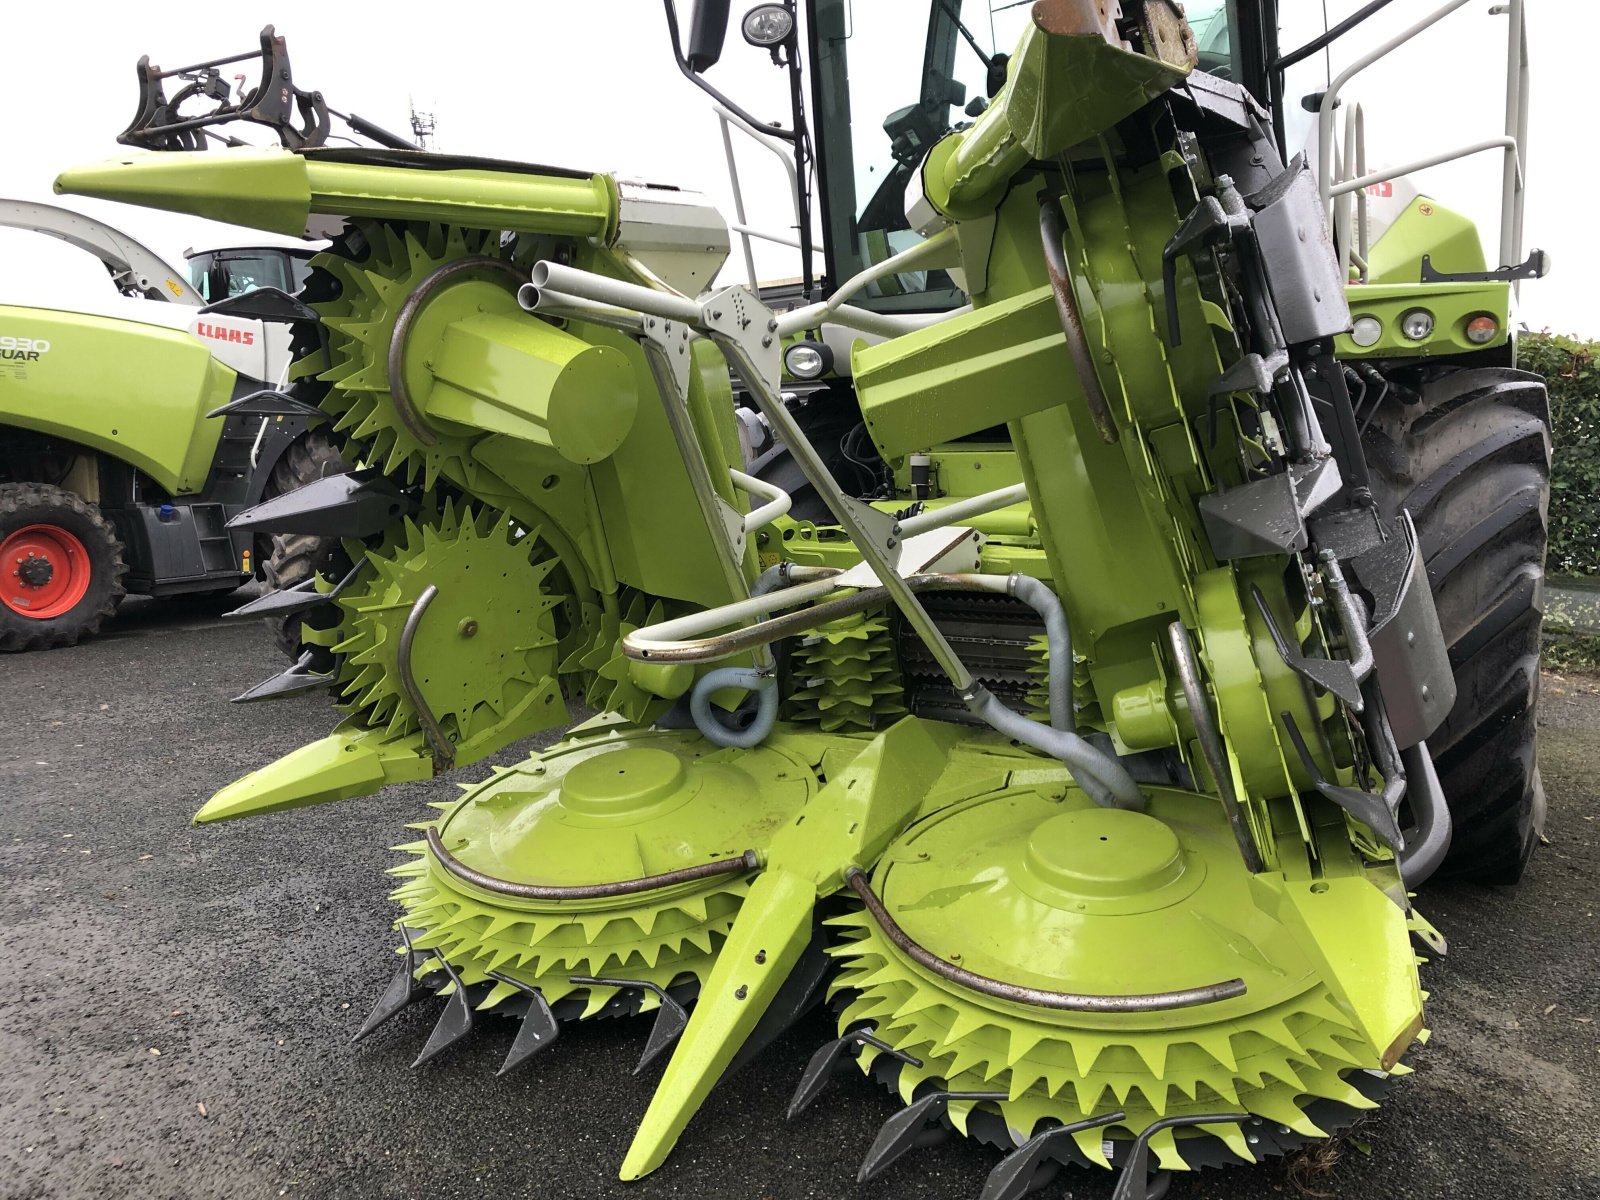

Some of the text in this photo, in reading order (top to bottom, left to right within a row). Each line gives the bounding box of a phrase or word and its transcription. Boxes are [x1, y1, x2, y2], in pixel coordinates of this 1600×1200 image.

[197, 322, 254, 345] CLAAS
[0, 336, 50, 352] 930
[0, 349, 39, 361] UAR
